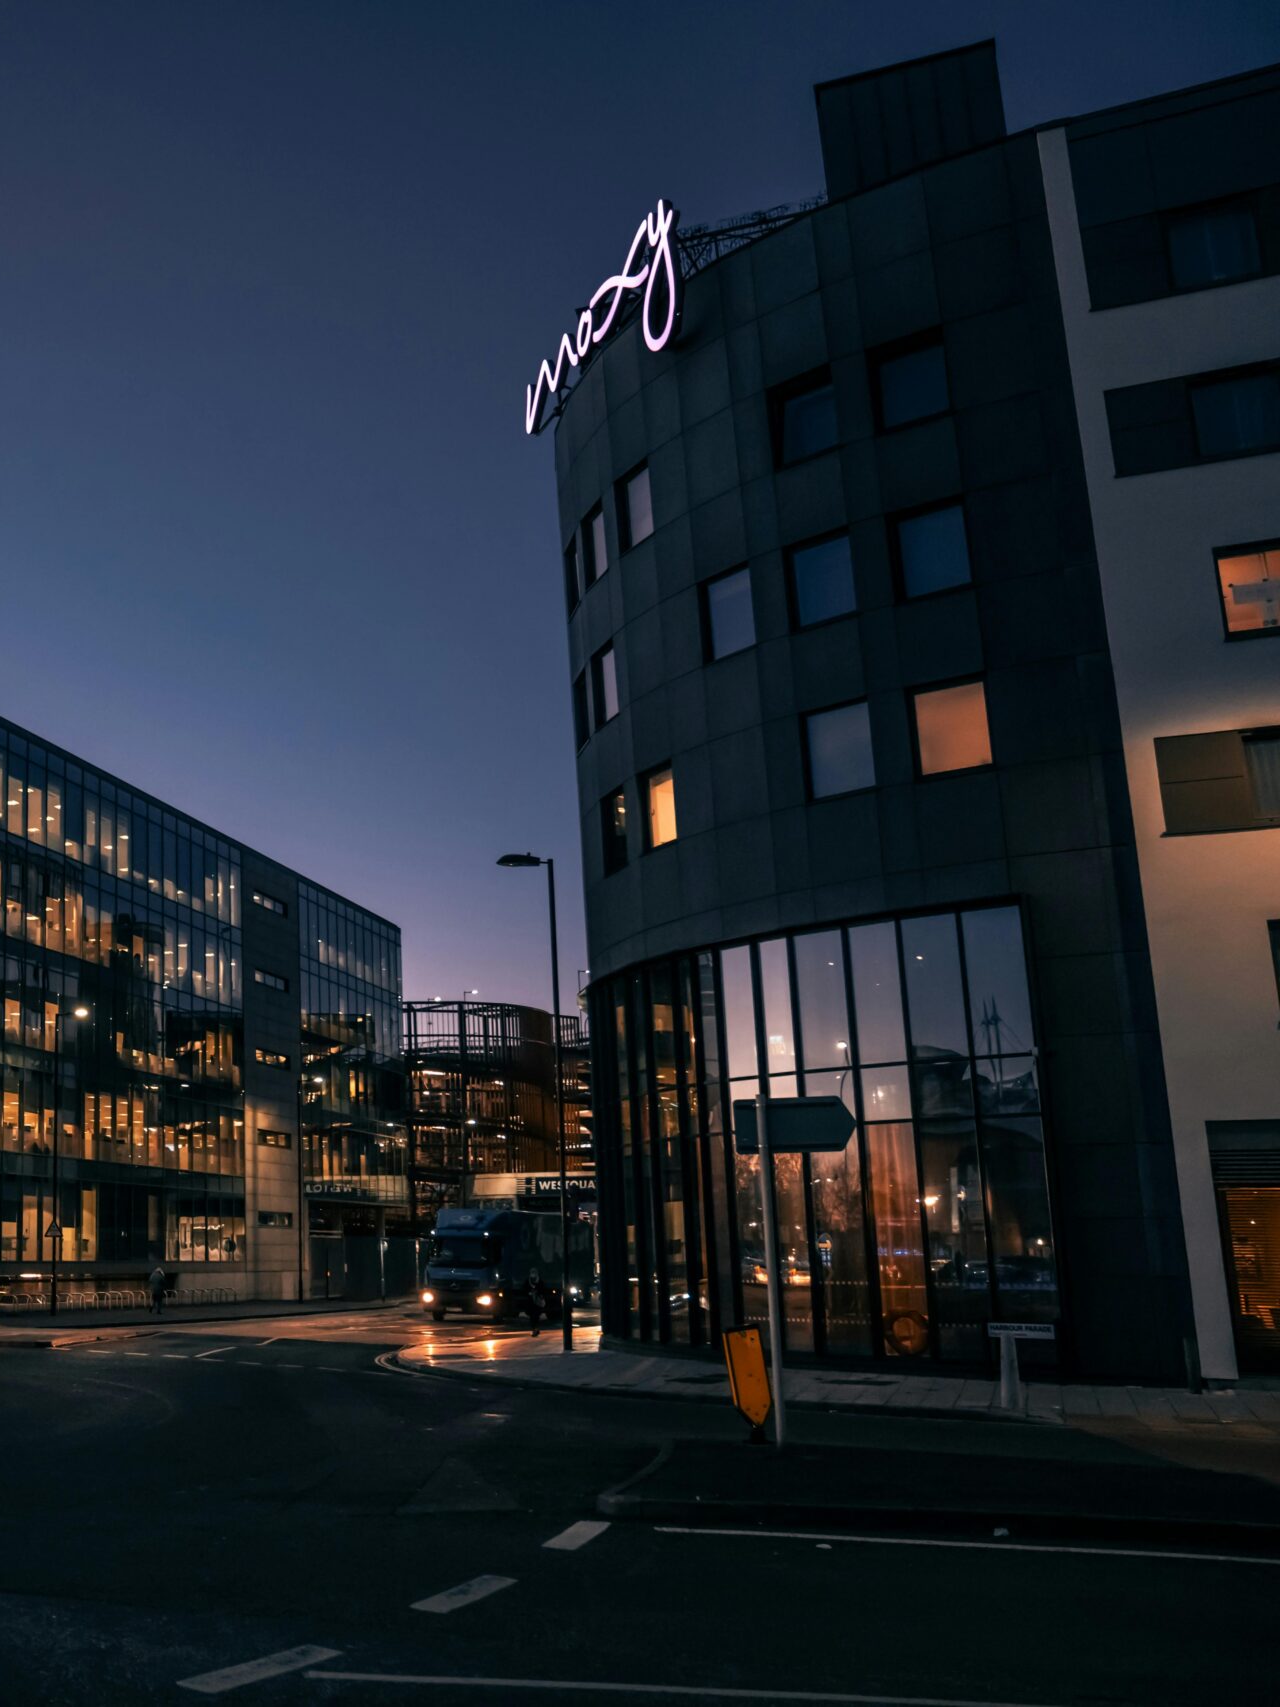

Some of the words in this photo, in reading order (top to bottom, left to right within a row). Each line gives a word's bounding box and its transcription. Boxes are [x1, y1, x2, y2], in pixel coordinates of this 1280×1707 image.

[526, 199, 675, 434] moxy
[538, 1180, 597, 1191] WESTQUA
[990, 1324, 1023, 1332] HARBOUR
